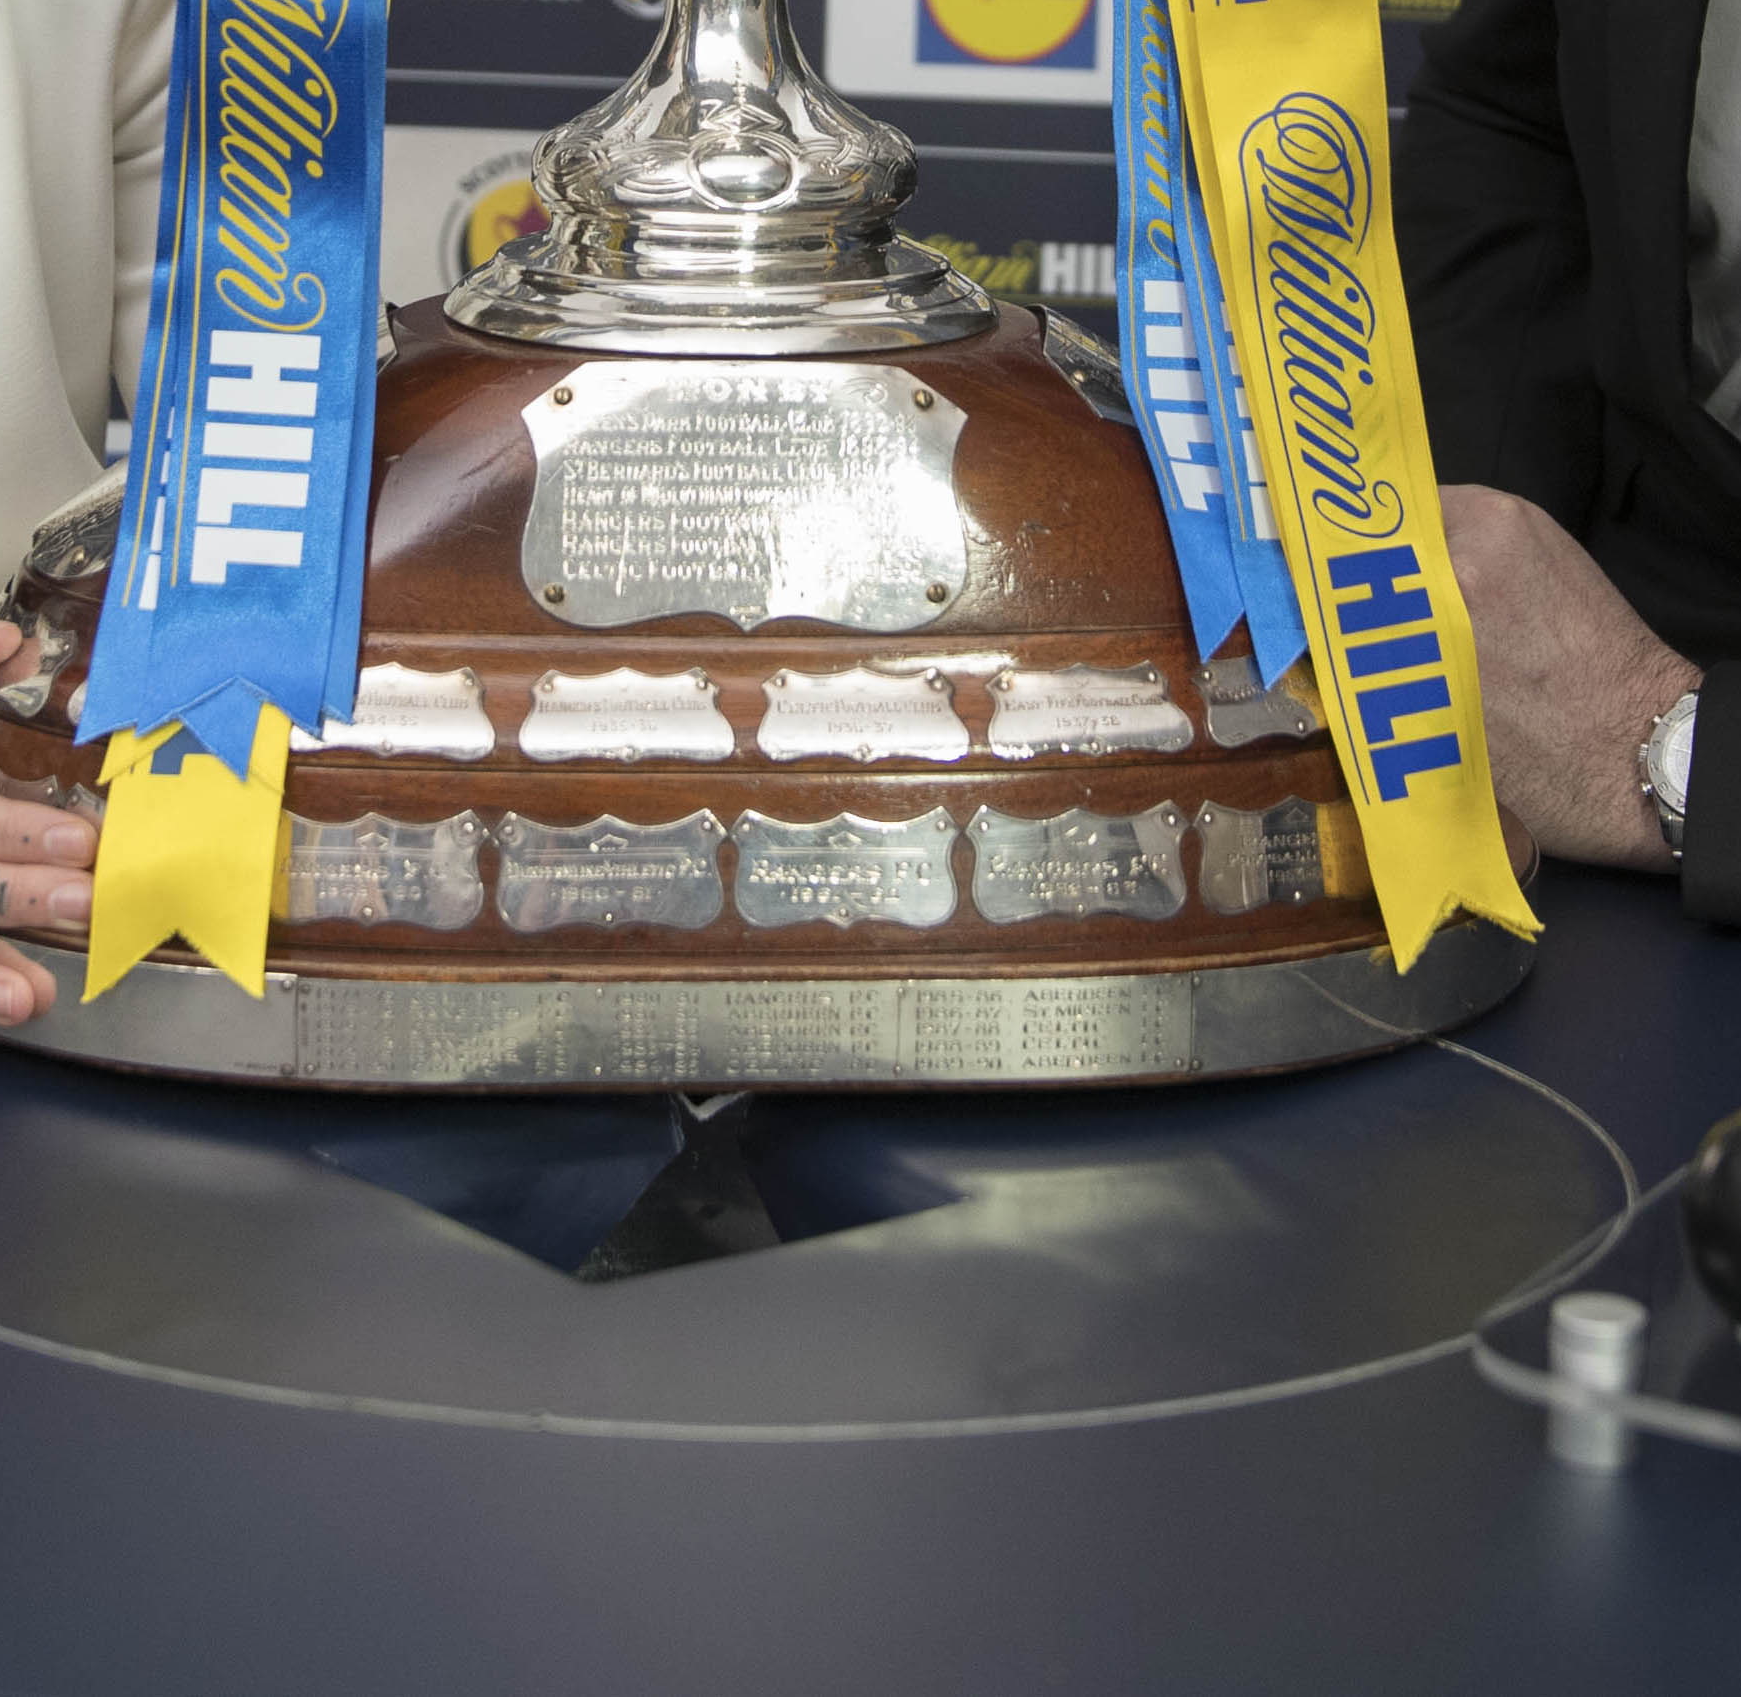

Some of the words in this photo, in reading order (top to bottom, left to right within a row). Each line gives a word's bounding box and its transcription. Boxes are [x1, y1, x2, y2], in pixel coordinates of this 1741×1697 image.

[189, 329, 322, 585] HILL
[1238, 92, 1407, 540] William
[1328, 544, 1463, 805] HILL
